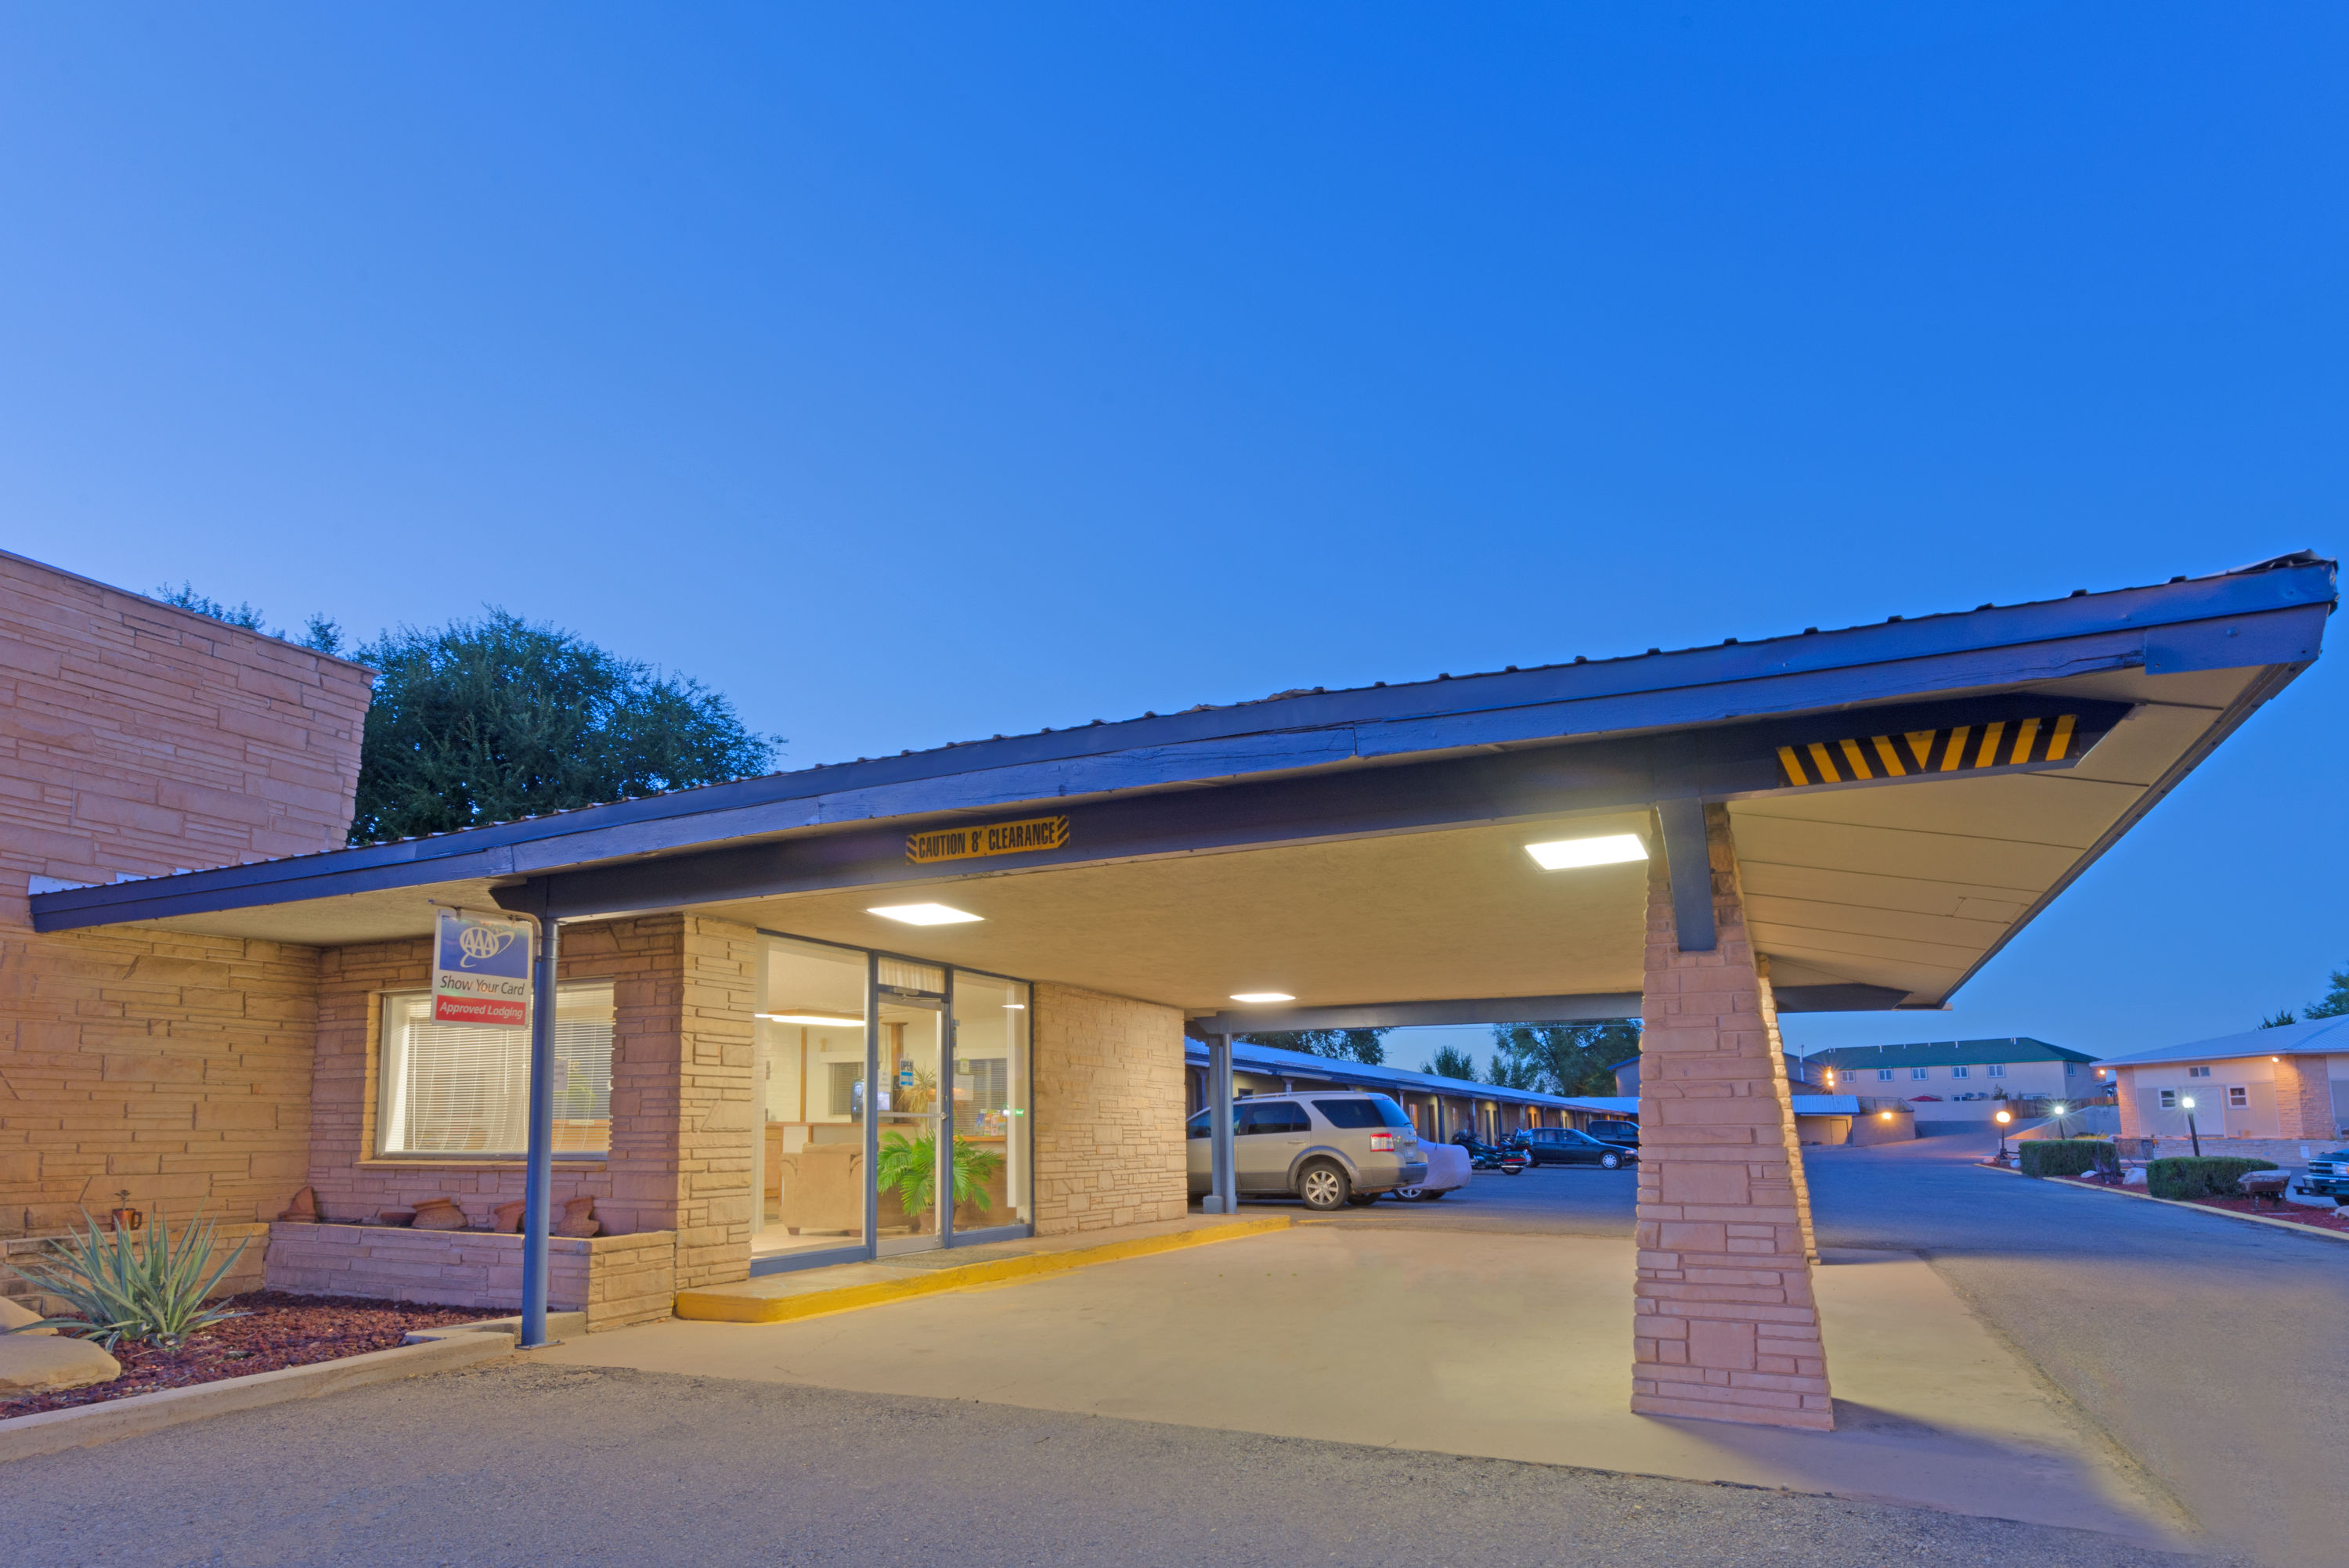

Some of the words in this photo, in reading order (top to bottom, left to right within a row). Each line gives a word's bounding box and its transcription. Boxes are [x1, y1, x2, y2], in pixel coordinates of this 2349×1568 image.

[918, 831, 965, 858] CAUTION
[988, 821, 1055, 851] CLEARANCE
[464, 928, 495, 958] AAA
[440, 975, 473, 990] Show
[476, 979, 499, 993] Your
[501, 982, 525, 996] Card
[439, 1001, 485, 1015] Approved
[487, 1005, 523, 1019] Lodging
[900, 1060, 913, 1071] OPEN
